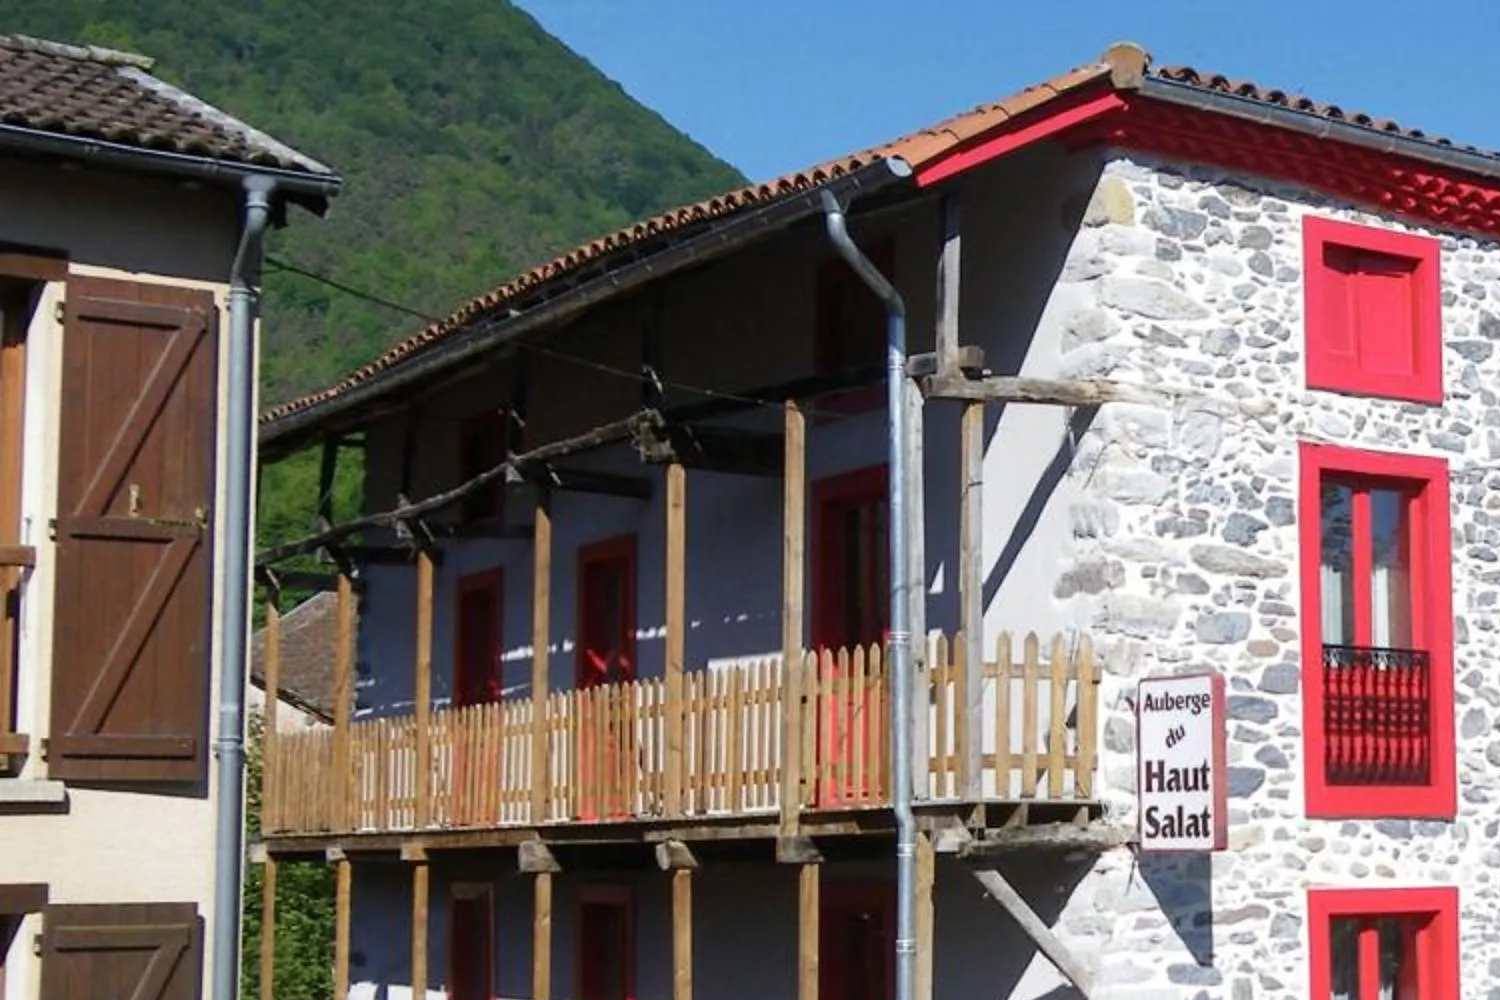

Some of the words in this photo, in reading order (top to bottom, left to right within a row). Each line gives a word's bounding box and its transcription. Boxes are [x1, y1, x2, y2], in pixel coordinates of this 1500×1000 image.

[1144, 691, 1210, 715] Auberge
[1165, 724, 1186, 748] du
[1145, 759, 1210, 793] Haut
[1145, 805, 1211, 839] Salat
